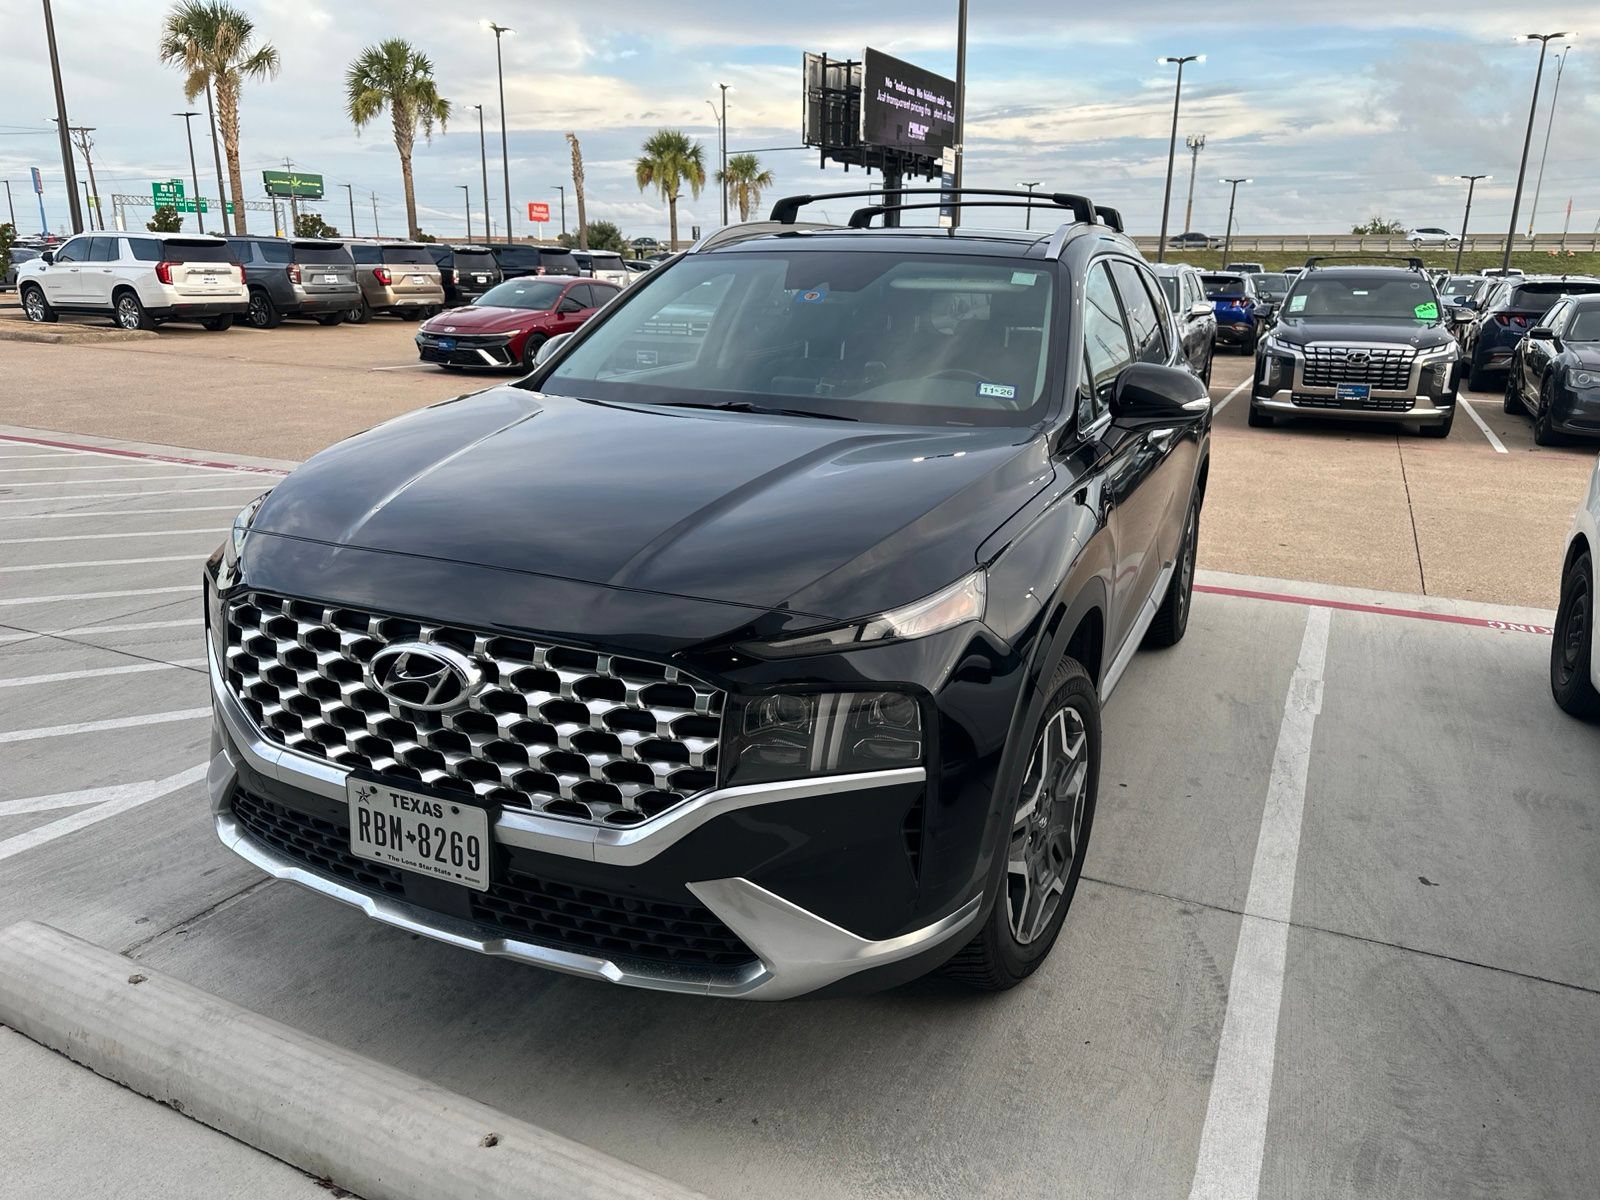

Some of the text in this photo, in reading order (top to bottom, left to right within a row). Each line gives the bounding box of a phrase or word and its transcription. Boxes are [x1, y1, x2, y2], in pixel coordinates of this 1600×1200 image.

[886, 93, 911, 110] transparent
[910, 101, 924, 117] pricing
[389, 793, 443, 819] TEXAS
[387, 854, 451, 876] The Lone Star State
